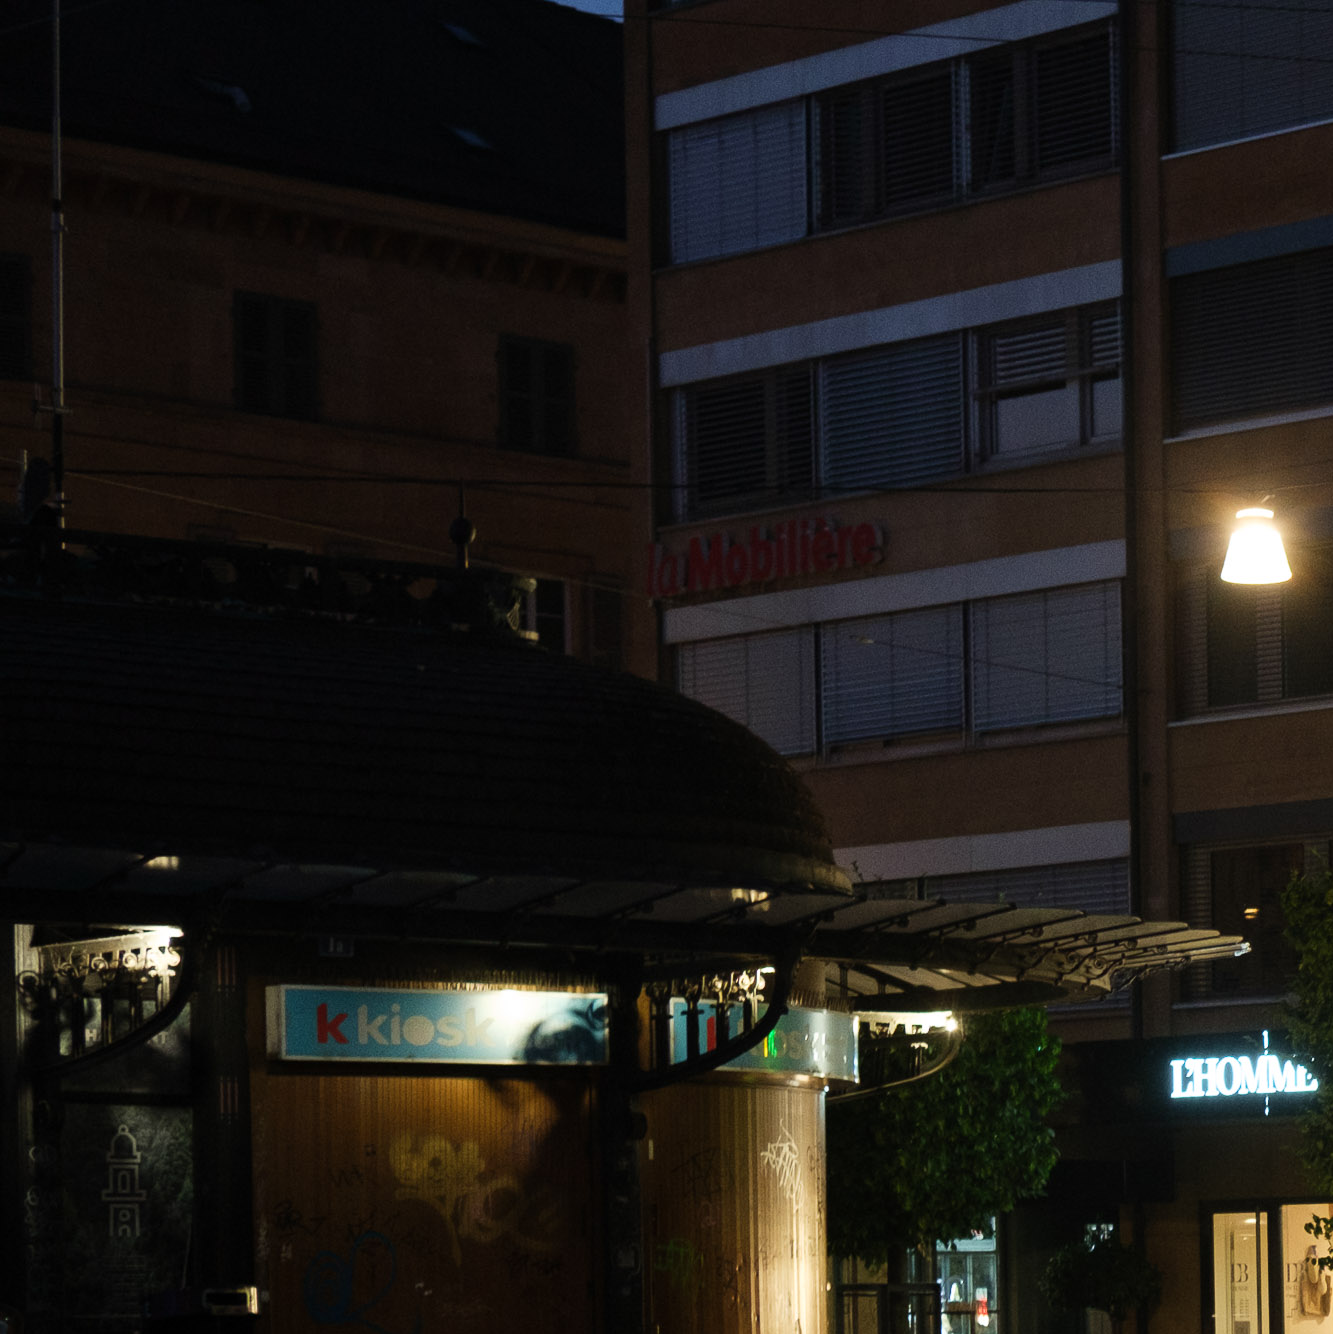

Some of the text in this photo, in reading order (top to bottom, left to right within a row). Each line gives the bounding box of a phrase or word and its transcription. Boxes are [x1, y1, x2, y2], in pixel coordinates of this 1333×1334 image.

[647, 517, 880, 597] la Mobilière
[316, 1003, 496, 1047] k kiosk
